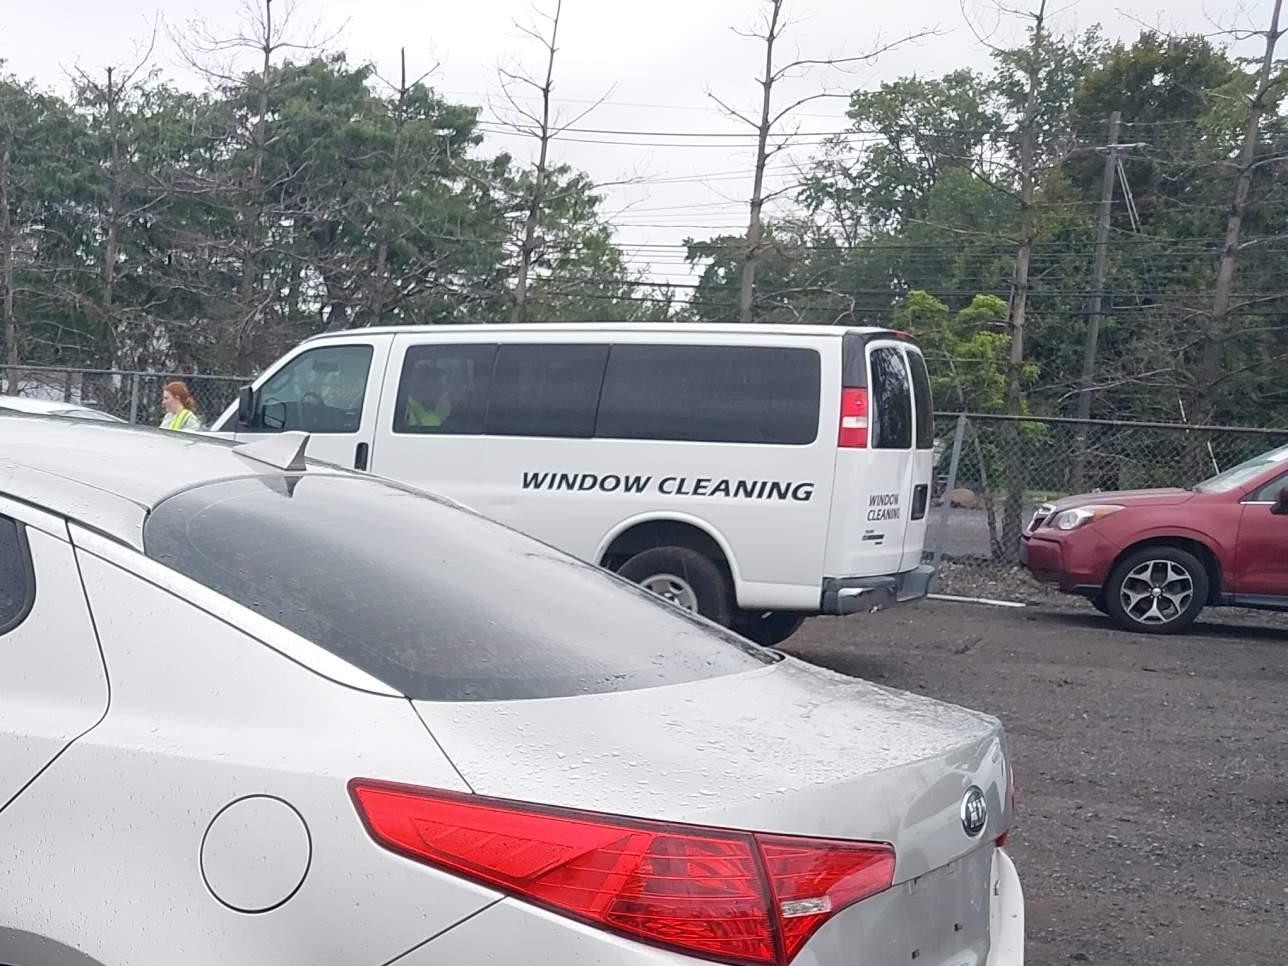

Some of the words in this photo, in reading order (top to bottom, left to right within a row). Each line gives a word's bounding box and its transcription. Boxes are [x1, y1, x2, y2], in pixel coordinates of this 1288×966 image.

[521, 472, 652, 493] WINDOW
[657, 477, 815, 501] CLEANING
[869, 494, 899, 506] WINDOW
